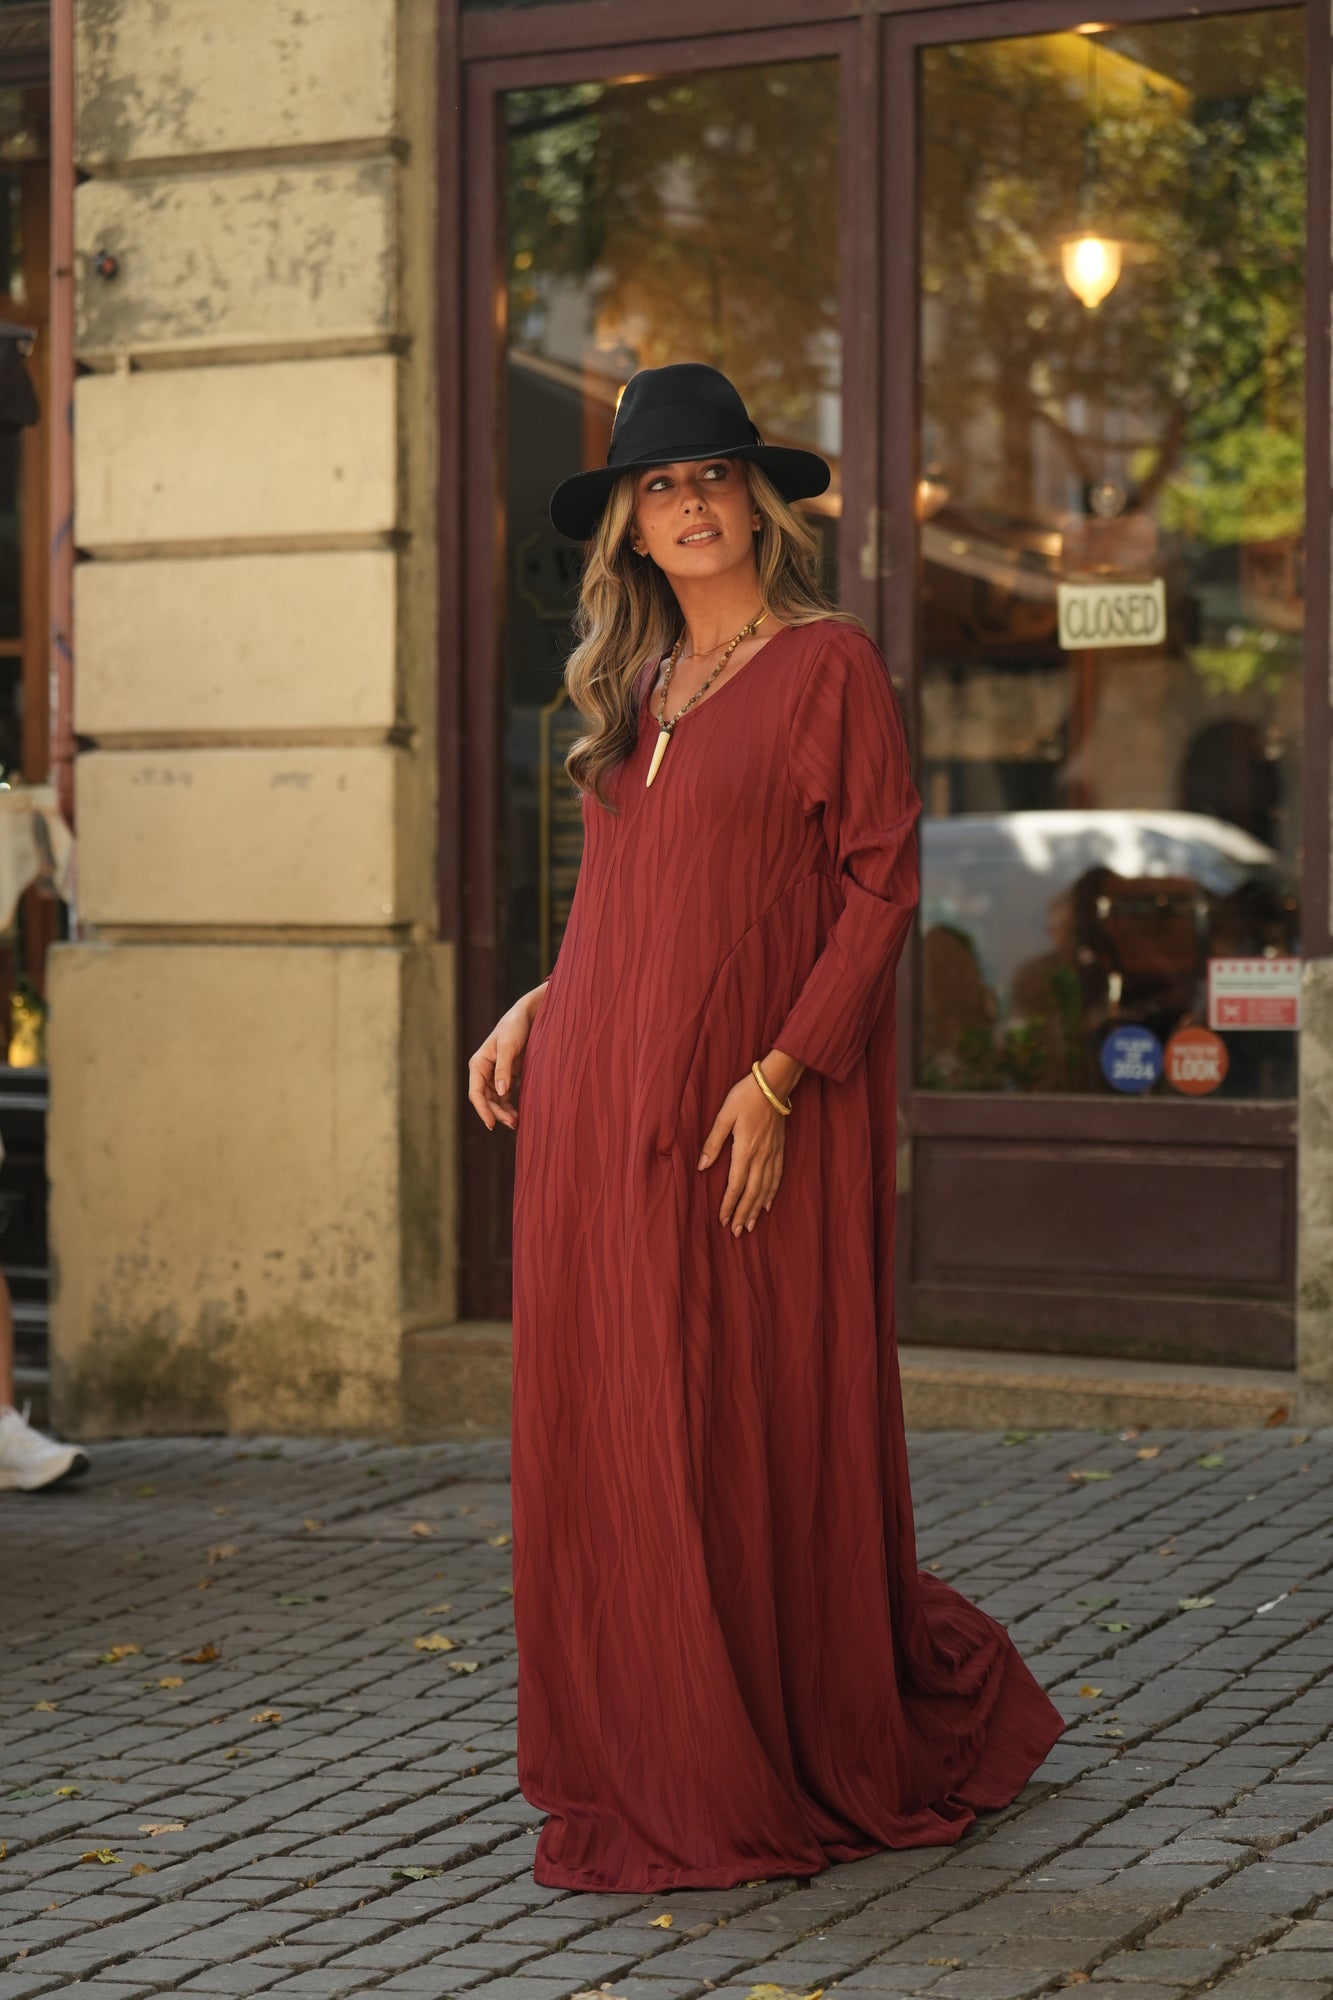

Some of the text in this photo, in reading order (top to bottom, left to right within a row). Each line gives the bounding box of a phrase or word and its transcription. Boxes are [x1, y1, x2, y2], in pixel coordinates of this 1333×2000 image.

[1065, 595, 1159, 639] CLOSED
[1113, 1061, 1155, 1080] 2024
[1172, 1059, 1220, 1081] LOOK
